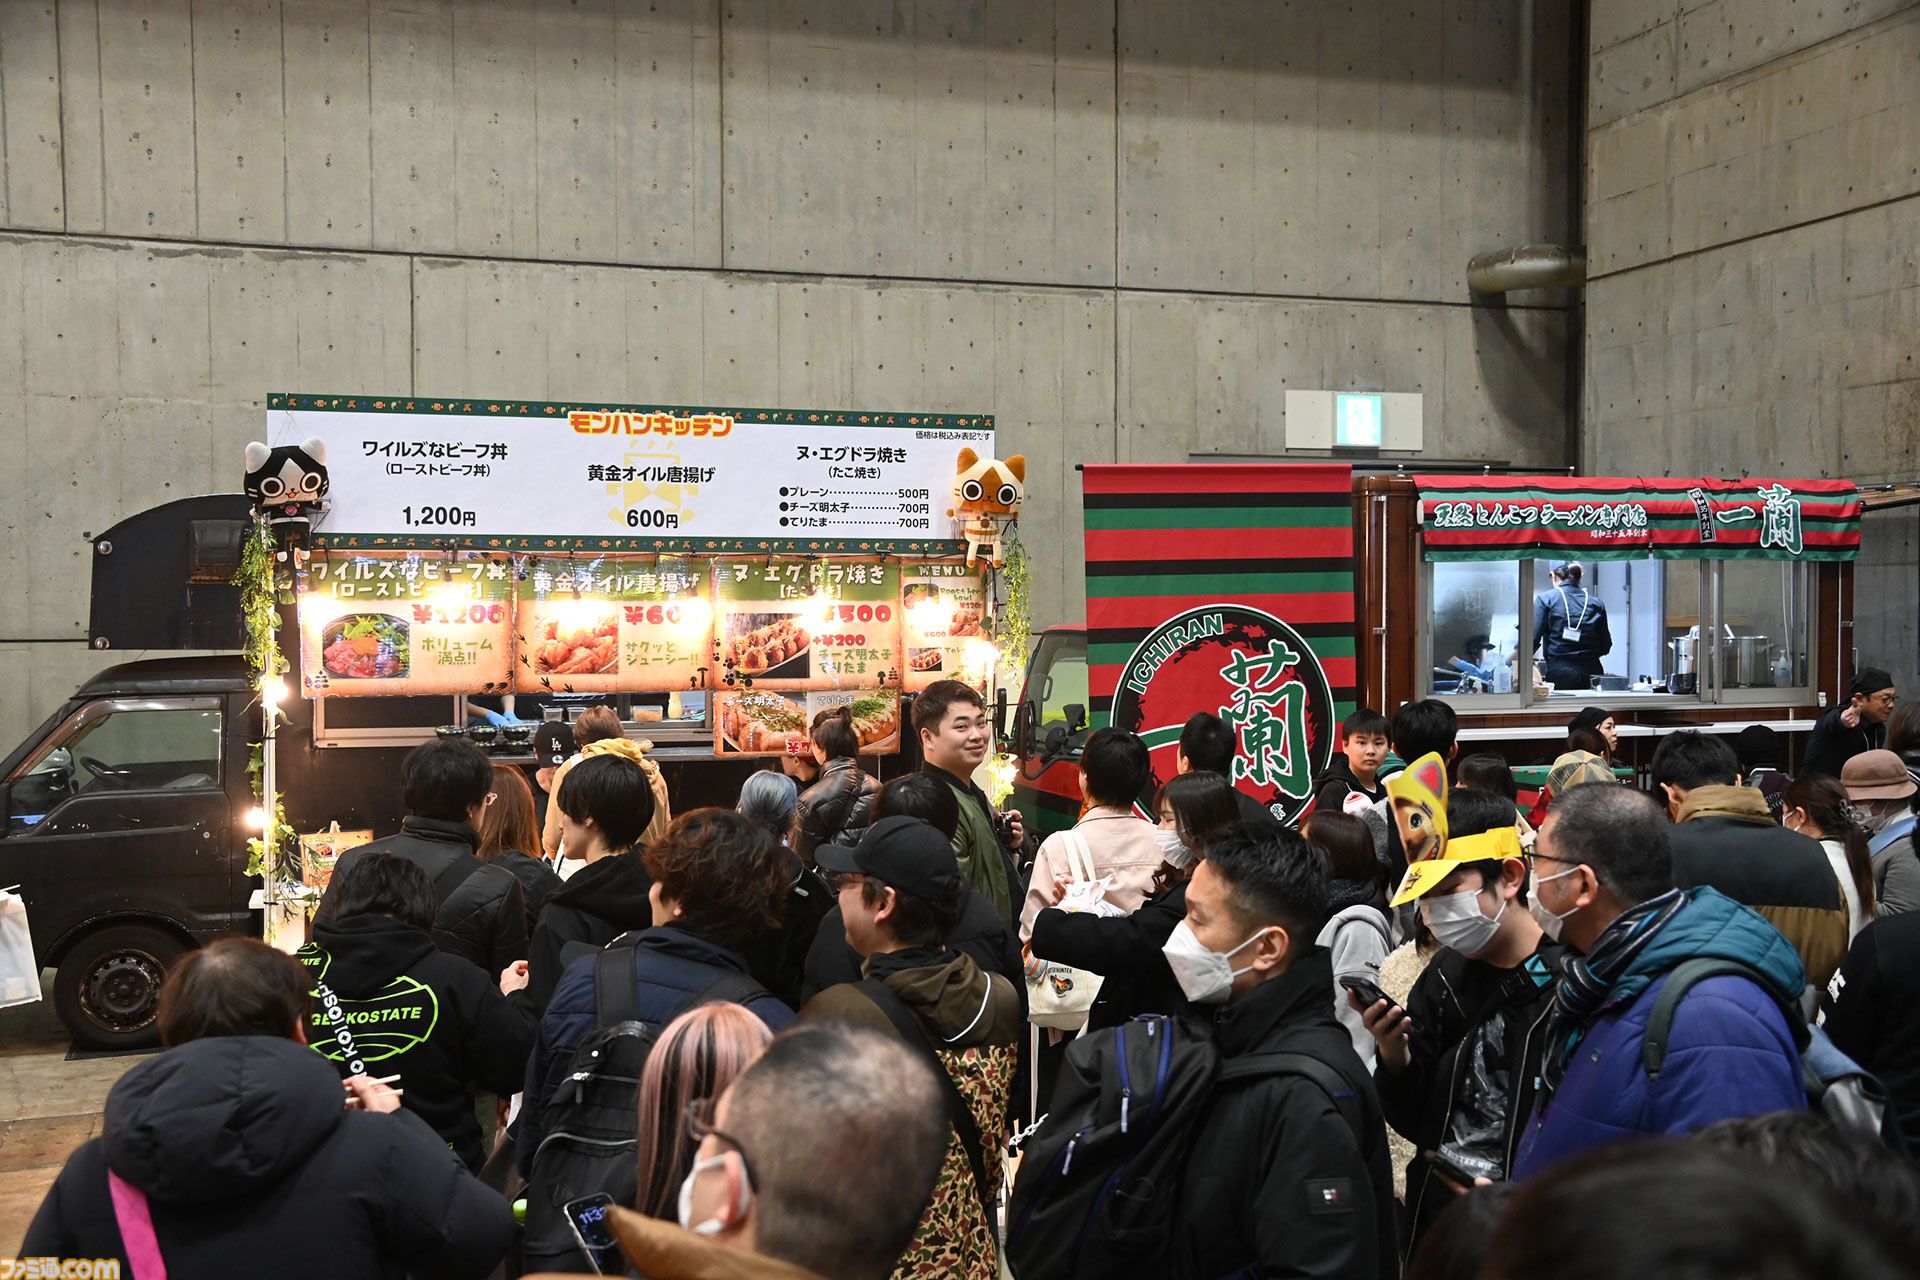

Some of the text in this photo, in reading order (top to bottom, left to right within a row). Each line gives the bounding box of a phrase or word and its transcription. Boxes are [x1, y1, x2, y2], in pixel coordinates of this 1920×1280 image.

[570, 412, 733, 437] モンハンキッチン
[362, 440, 508, 460] ワイルズなビーフ丼
[796, 446, 907, 463] ヌ・エグドラ焼き
[385, 462, 491, 477] (ローストビーフ丼)
[587, 464, 716, 483] 黄金オイル唐揚げ
[828, 465, 881, 479] (たこ焼き)
[898, 488, 929, 499] 500円
[402, 506, 476, 526] 1,200円
[899, 503, 929, 514] 700円
[626, 509, 678, 529] 600円
[899, 517, 929, 529] 700円
[311, 561, 507, 581] ワイルズなビーフ丼
[733, 564, 885, 586] ヌ・エグドラ焼き
[919, 565, 966, 577] MENU
[533, 572, 700, 593] 黄金オイル唐揚げ
[623, 605, 683, 625] ¥60
[422, 637, 493, 651] ボリューム
[626, 641, 680, 653] サクッと
[438, 651, 476, 665] 満点!!
[819, 649, 891, 660] チーズ明太子
[1127, 613, 1225, 695] ICHIRAN
[726, 696, 786, 707] チーズ明太子
[551, 737, 562, 751] LA
[311, 1006, 423, 1026] GEKOSTATE
